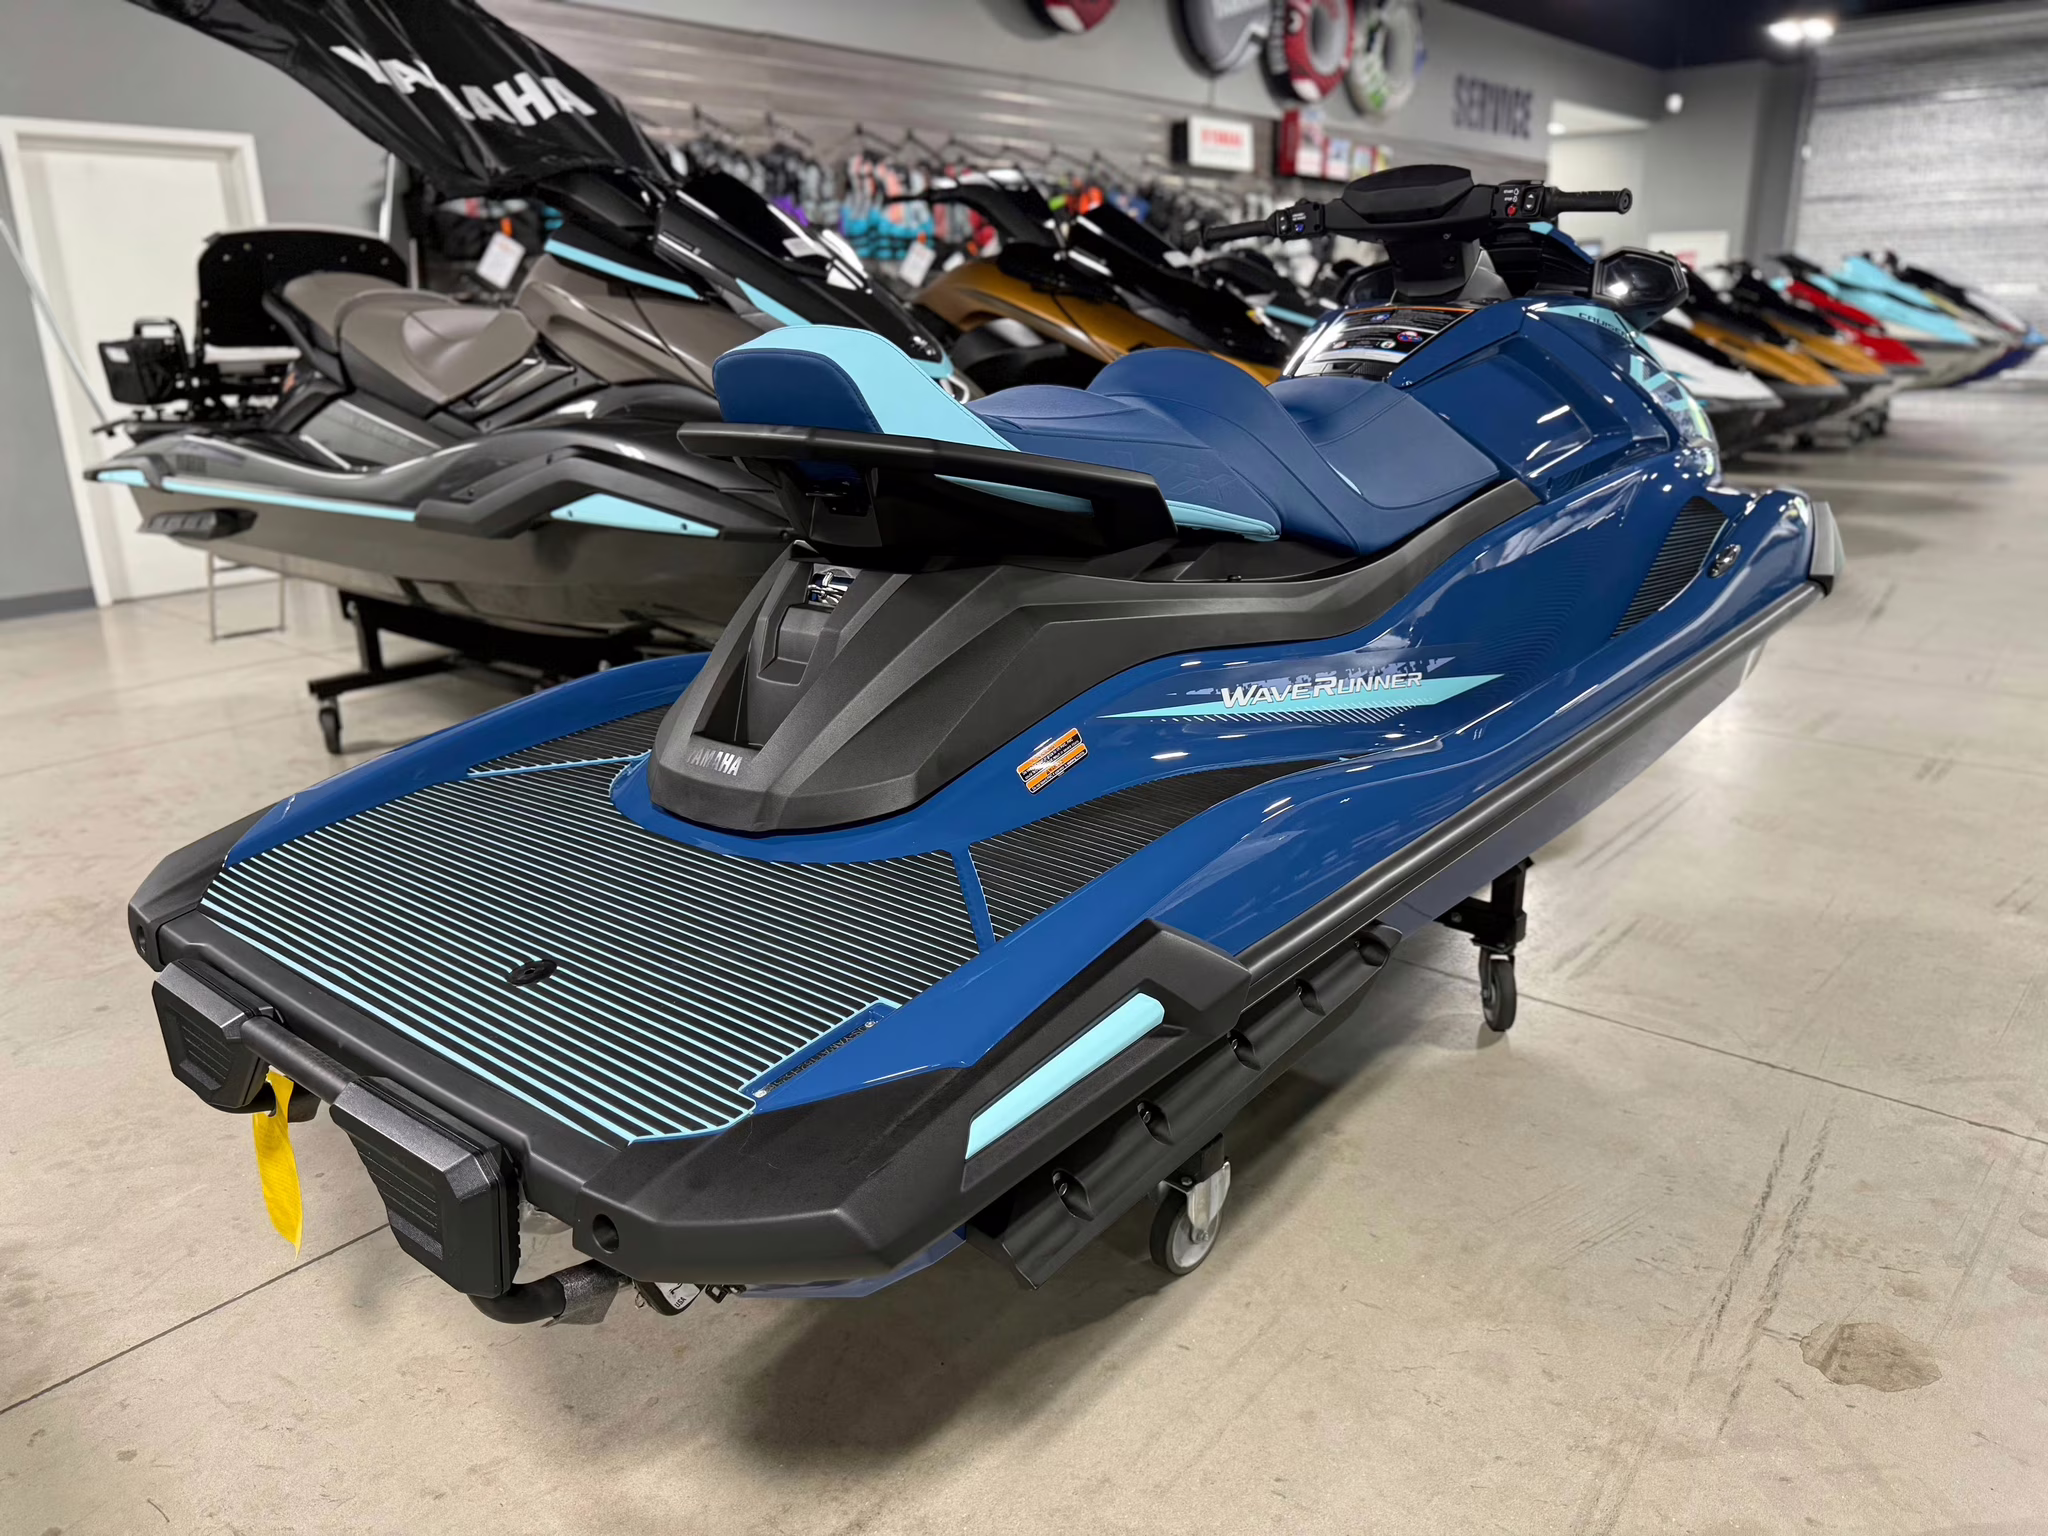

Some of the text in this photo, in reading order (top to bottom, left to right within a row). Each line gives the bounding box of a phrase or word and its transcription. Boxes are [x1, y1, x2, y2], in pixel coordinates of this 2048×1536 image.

[1452, 74, 1534, 139] SERVICE
[1221, 672, 1423, 709] WAVERUNNER
[686, 747, 743, 776] YAMAHA
[674, 1296, 687, 1308] USA
